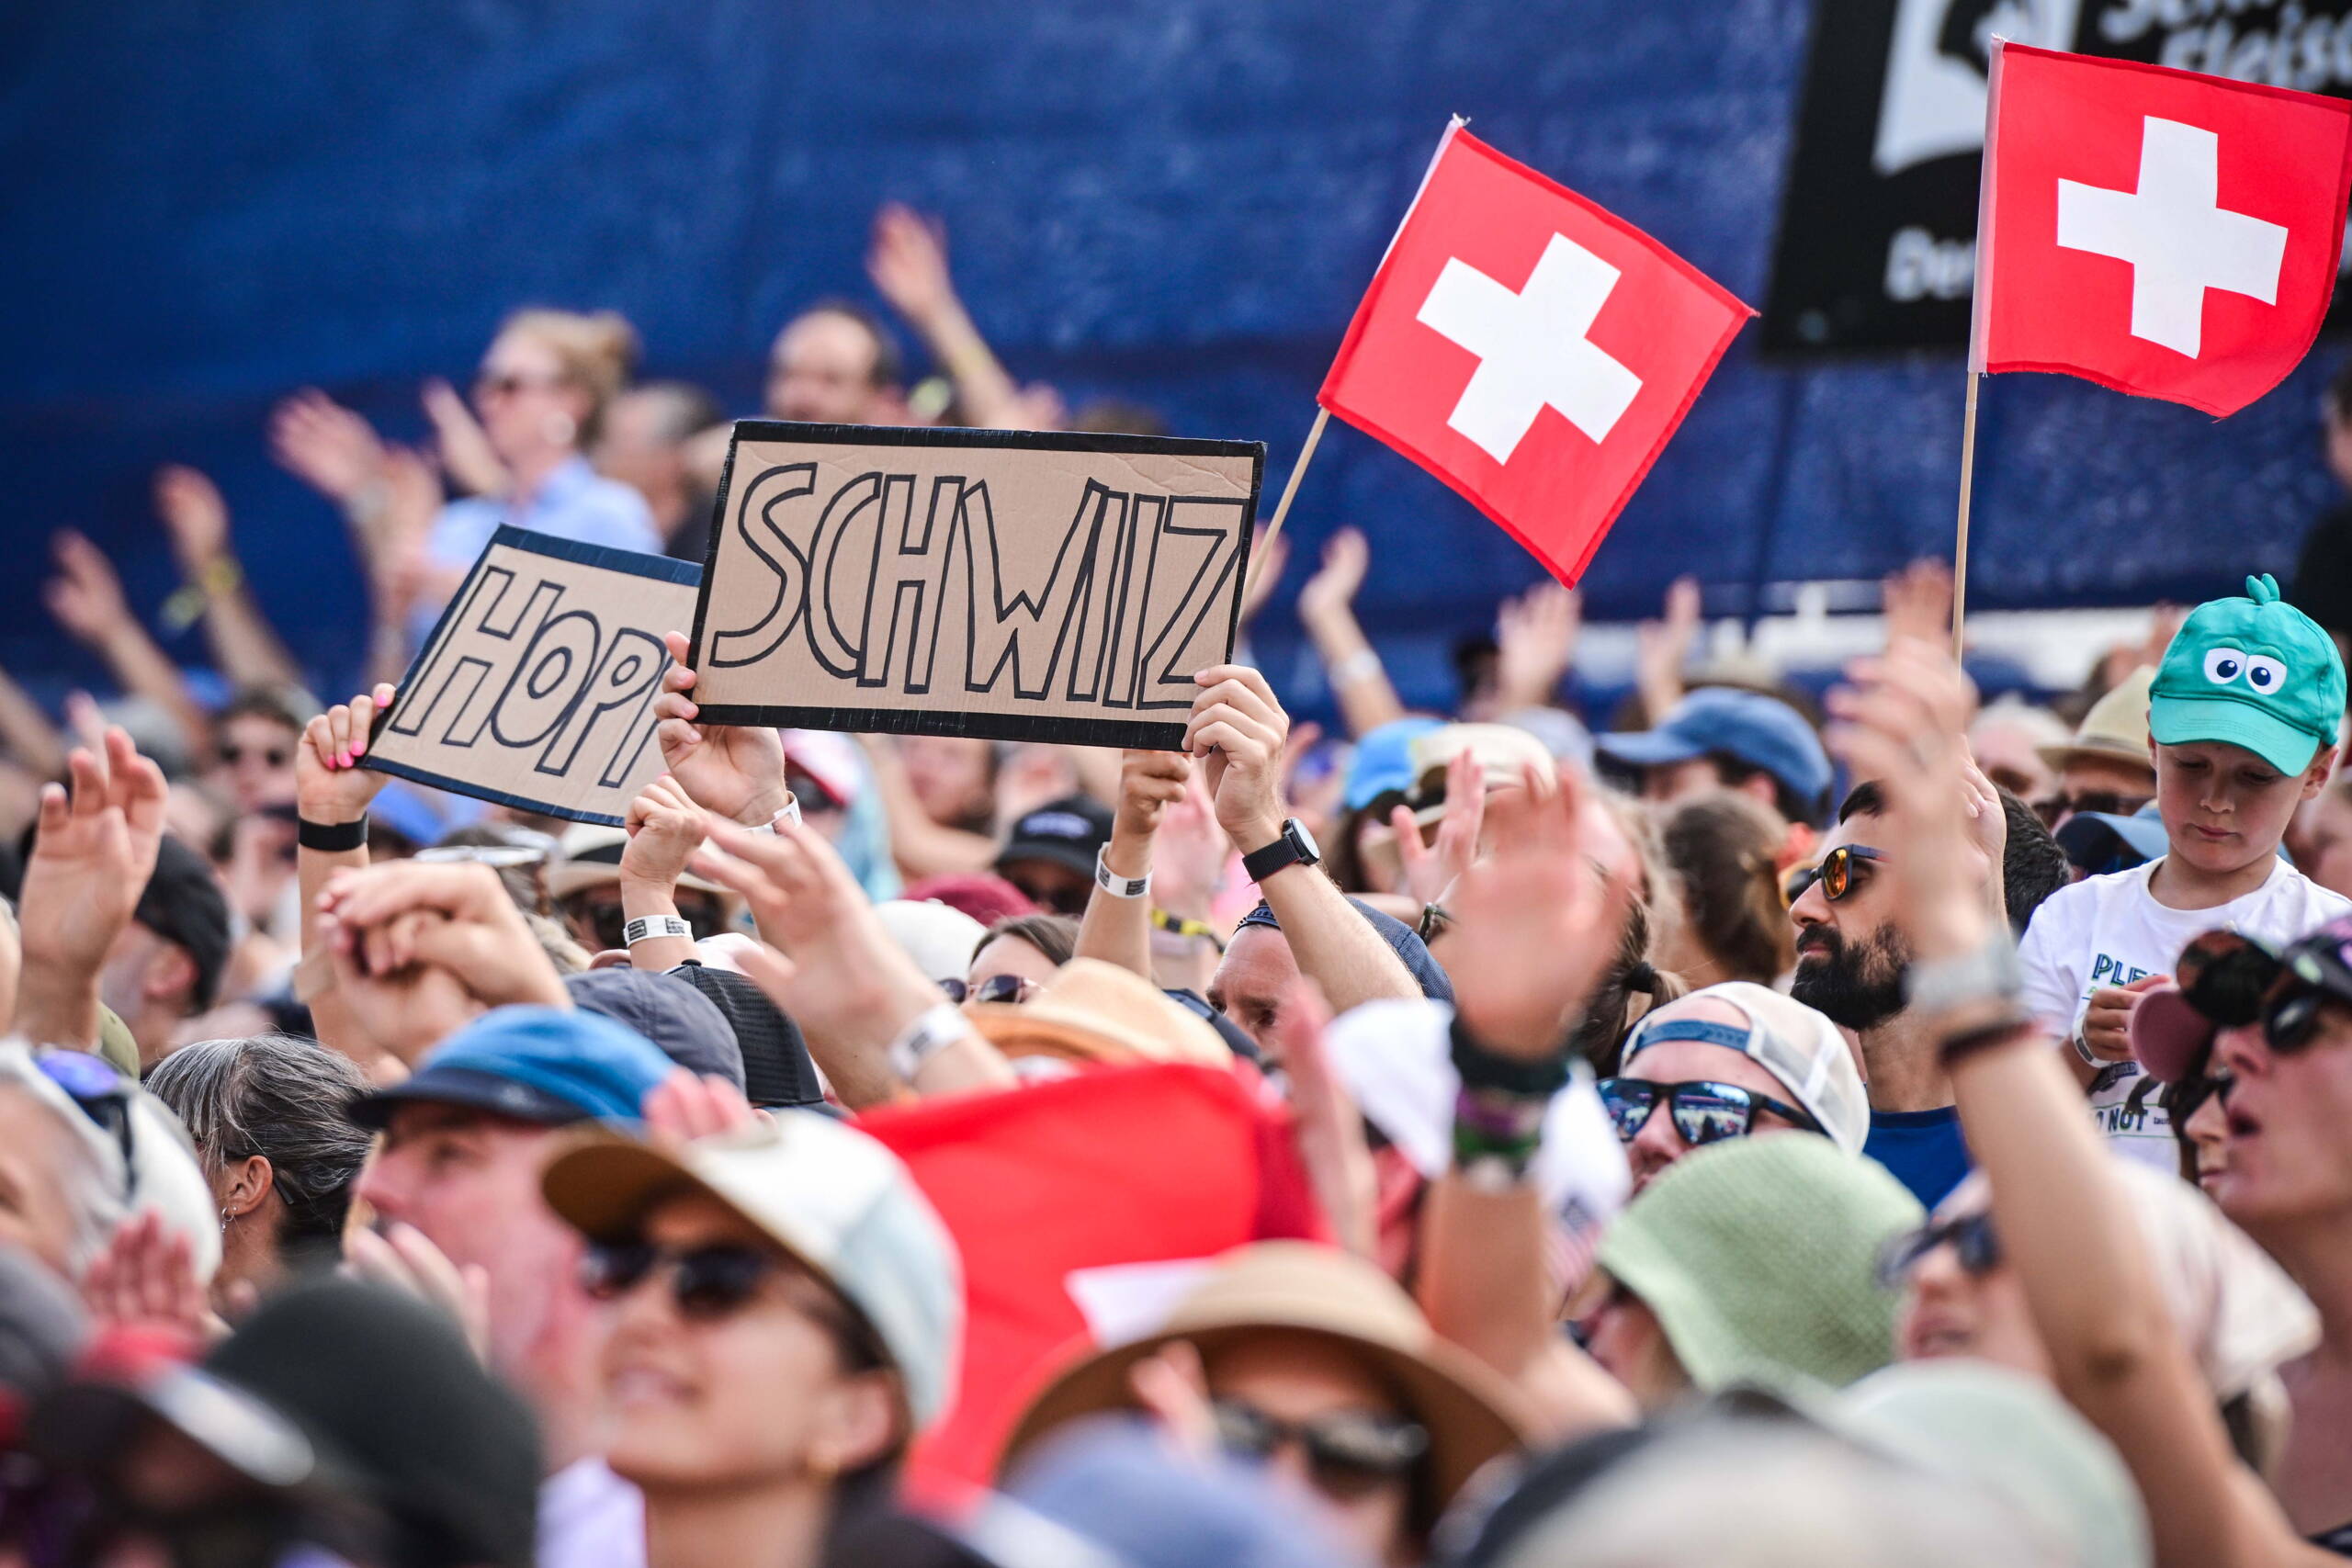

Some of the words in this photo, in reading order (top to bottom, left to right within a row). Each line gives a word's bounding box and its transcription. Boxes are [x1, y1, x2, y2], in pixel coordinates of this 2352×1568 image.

[709, 462, 1250, 710] SCHWIIZ
[2092, 953, 2160, 987] PLE
[2109, 1108, 2148, 1132] NOT
